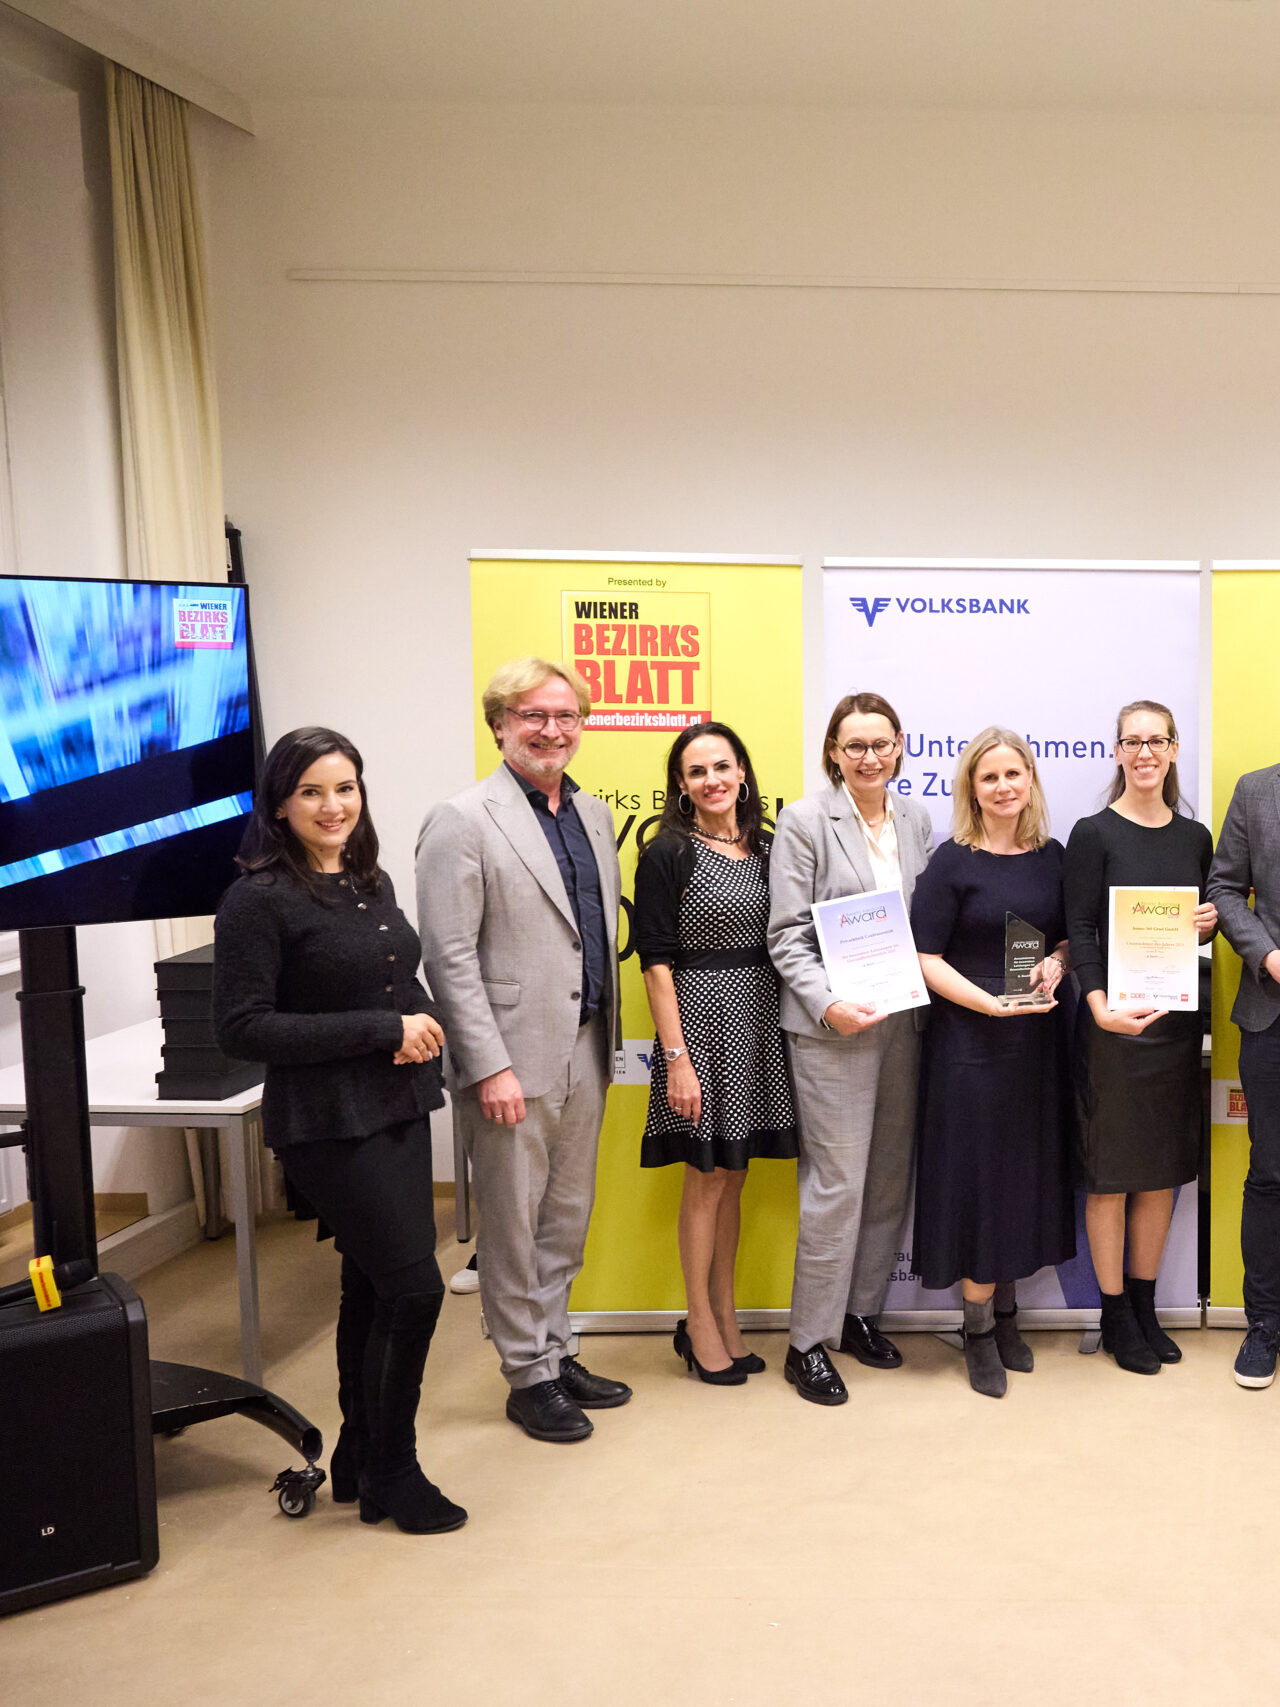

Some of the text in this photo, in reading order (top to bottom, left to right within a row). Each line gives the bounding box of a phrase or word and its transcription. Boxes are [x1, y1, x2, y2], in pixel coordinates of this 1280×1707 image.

[607, 577, 667, 588] Presented by
[574, 601, 639, 619] WIENER
[895, 597, 1031, 614] VOLKSBANK
[178, 610, 228, 623] BEZIRKS
[573, 623, 700, 657] BEZIRKS
[574, 659, 700, 704] BLATT
[584, 712, 702, 727] ienerbezirksblatt.at
[840, 905, 887, 928] Award
[1132, 902, 1180, 915] Award
[41, 1526, 55, 1536] LD
